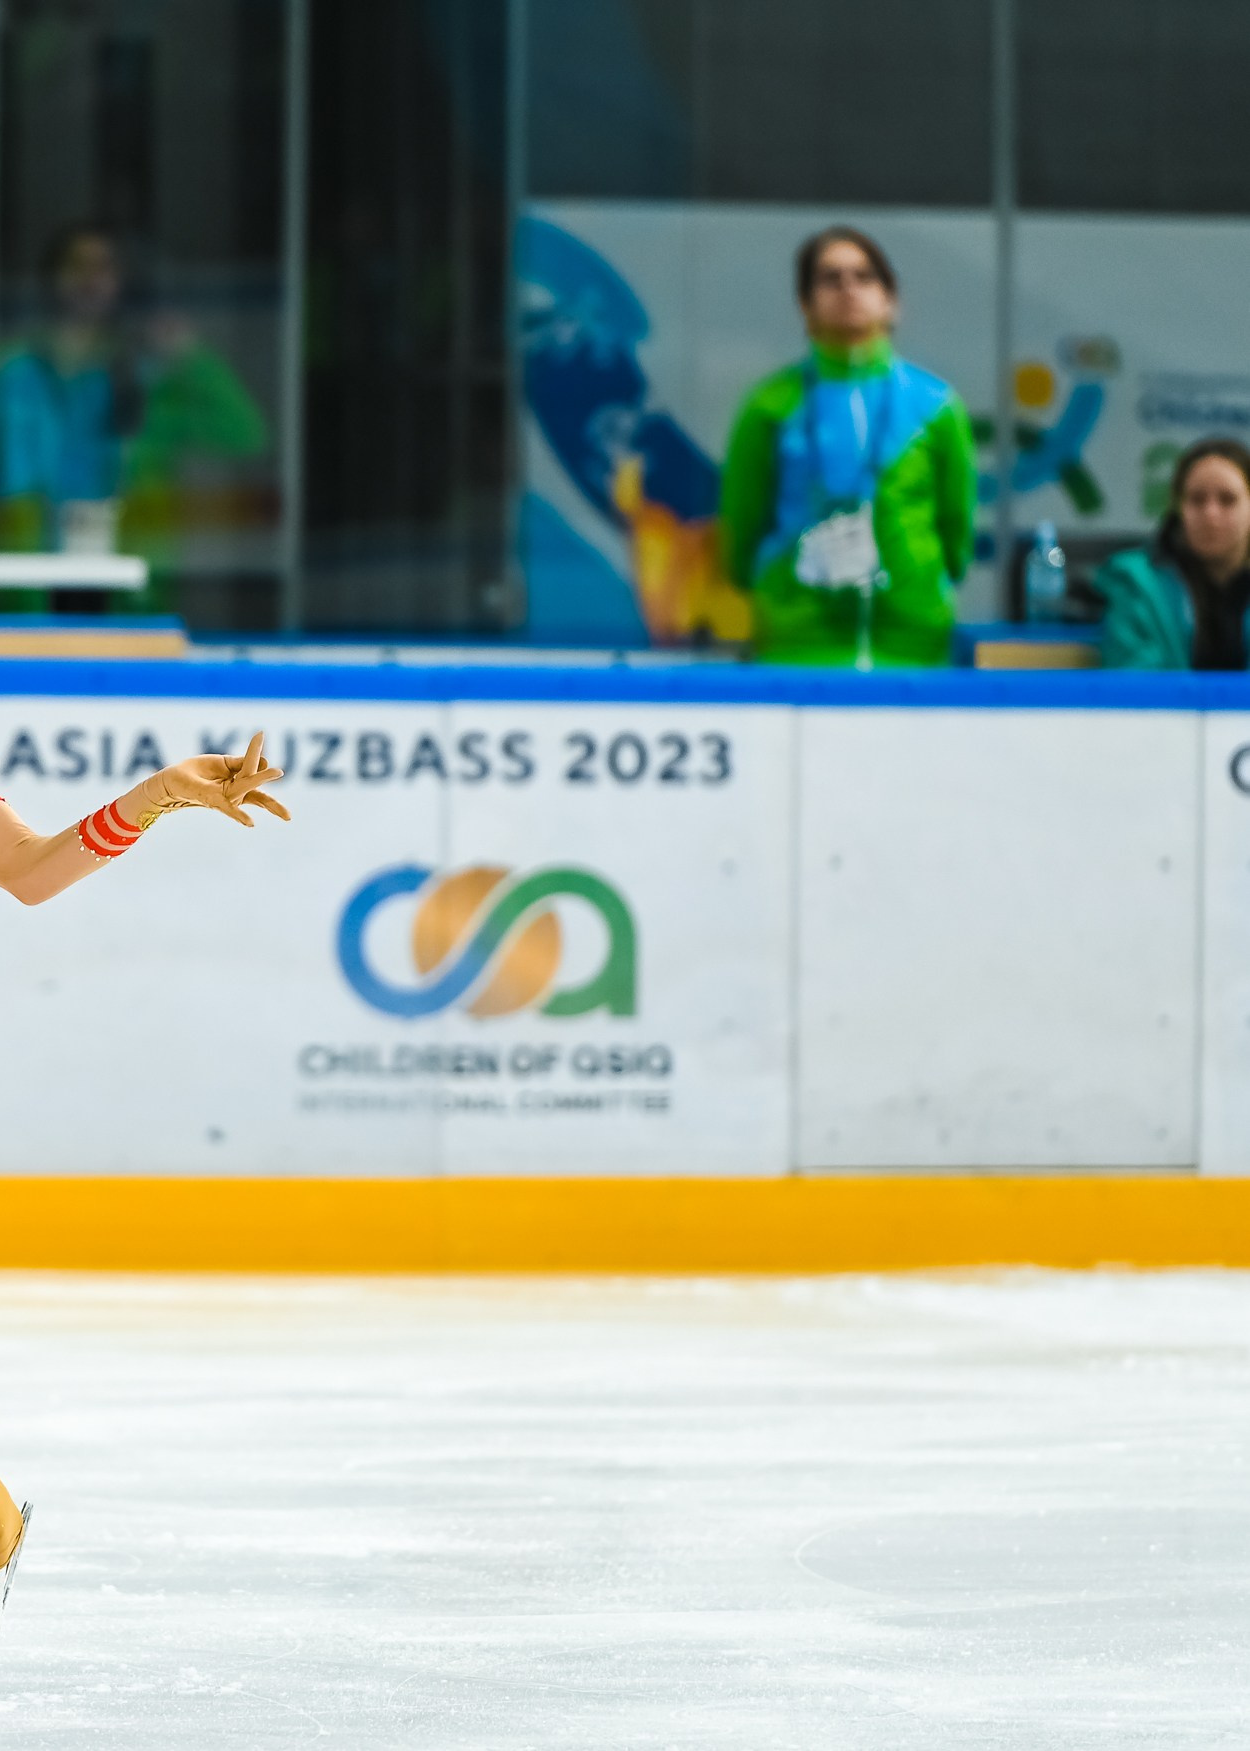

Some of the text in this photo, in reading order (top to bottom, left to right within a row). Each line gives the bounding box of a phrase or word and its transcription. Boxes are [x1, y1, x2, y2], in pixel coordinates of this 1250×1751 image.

[0, 727, 167, 779] ASIA
[564, 731, 733, 784] 2023
[300, 1043, 499, 1078] CHILDREN
[509, 1044, 559, 1078] OF
